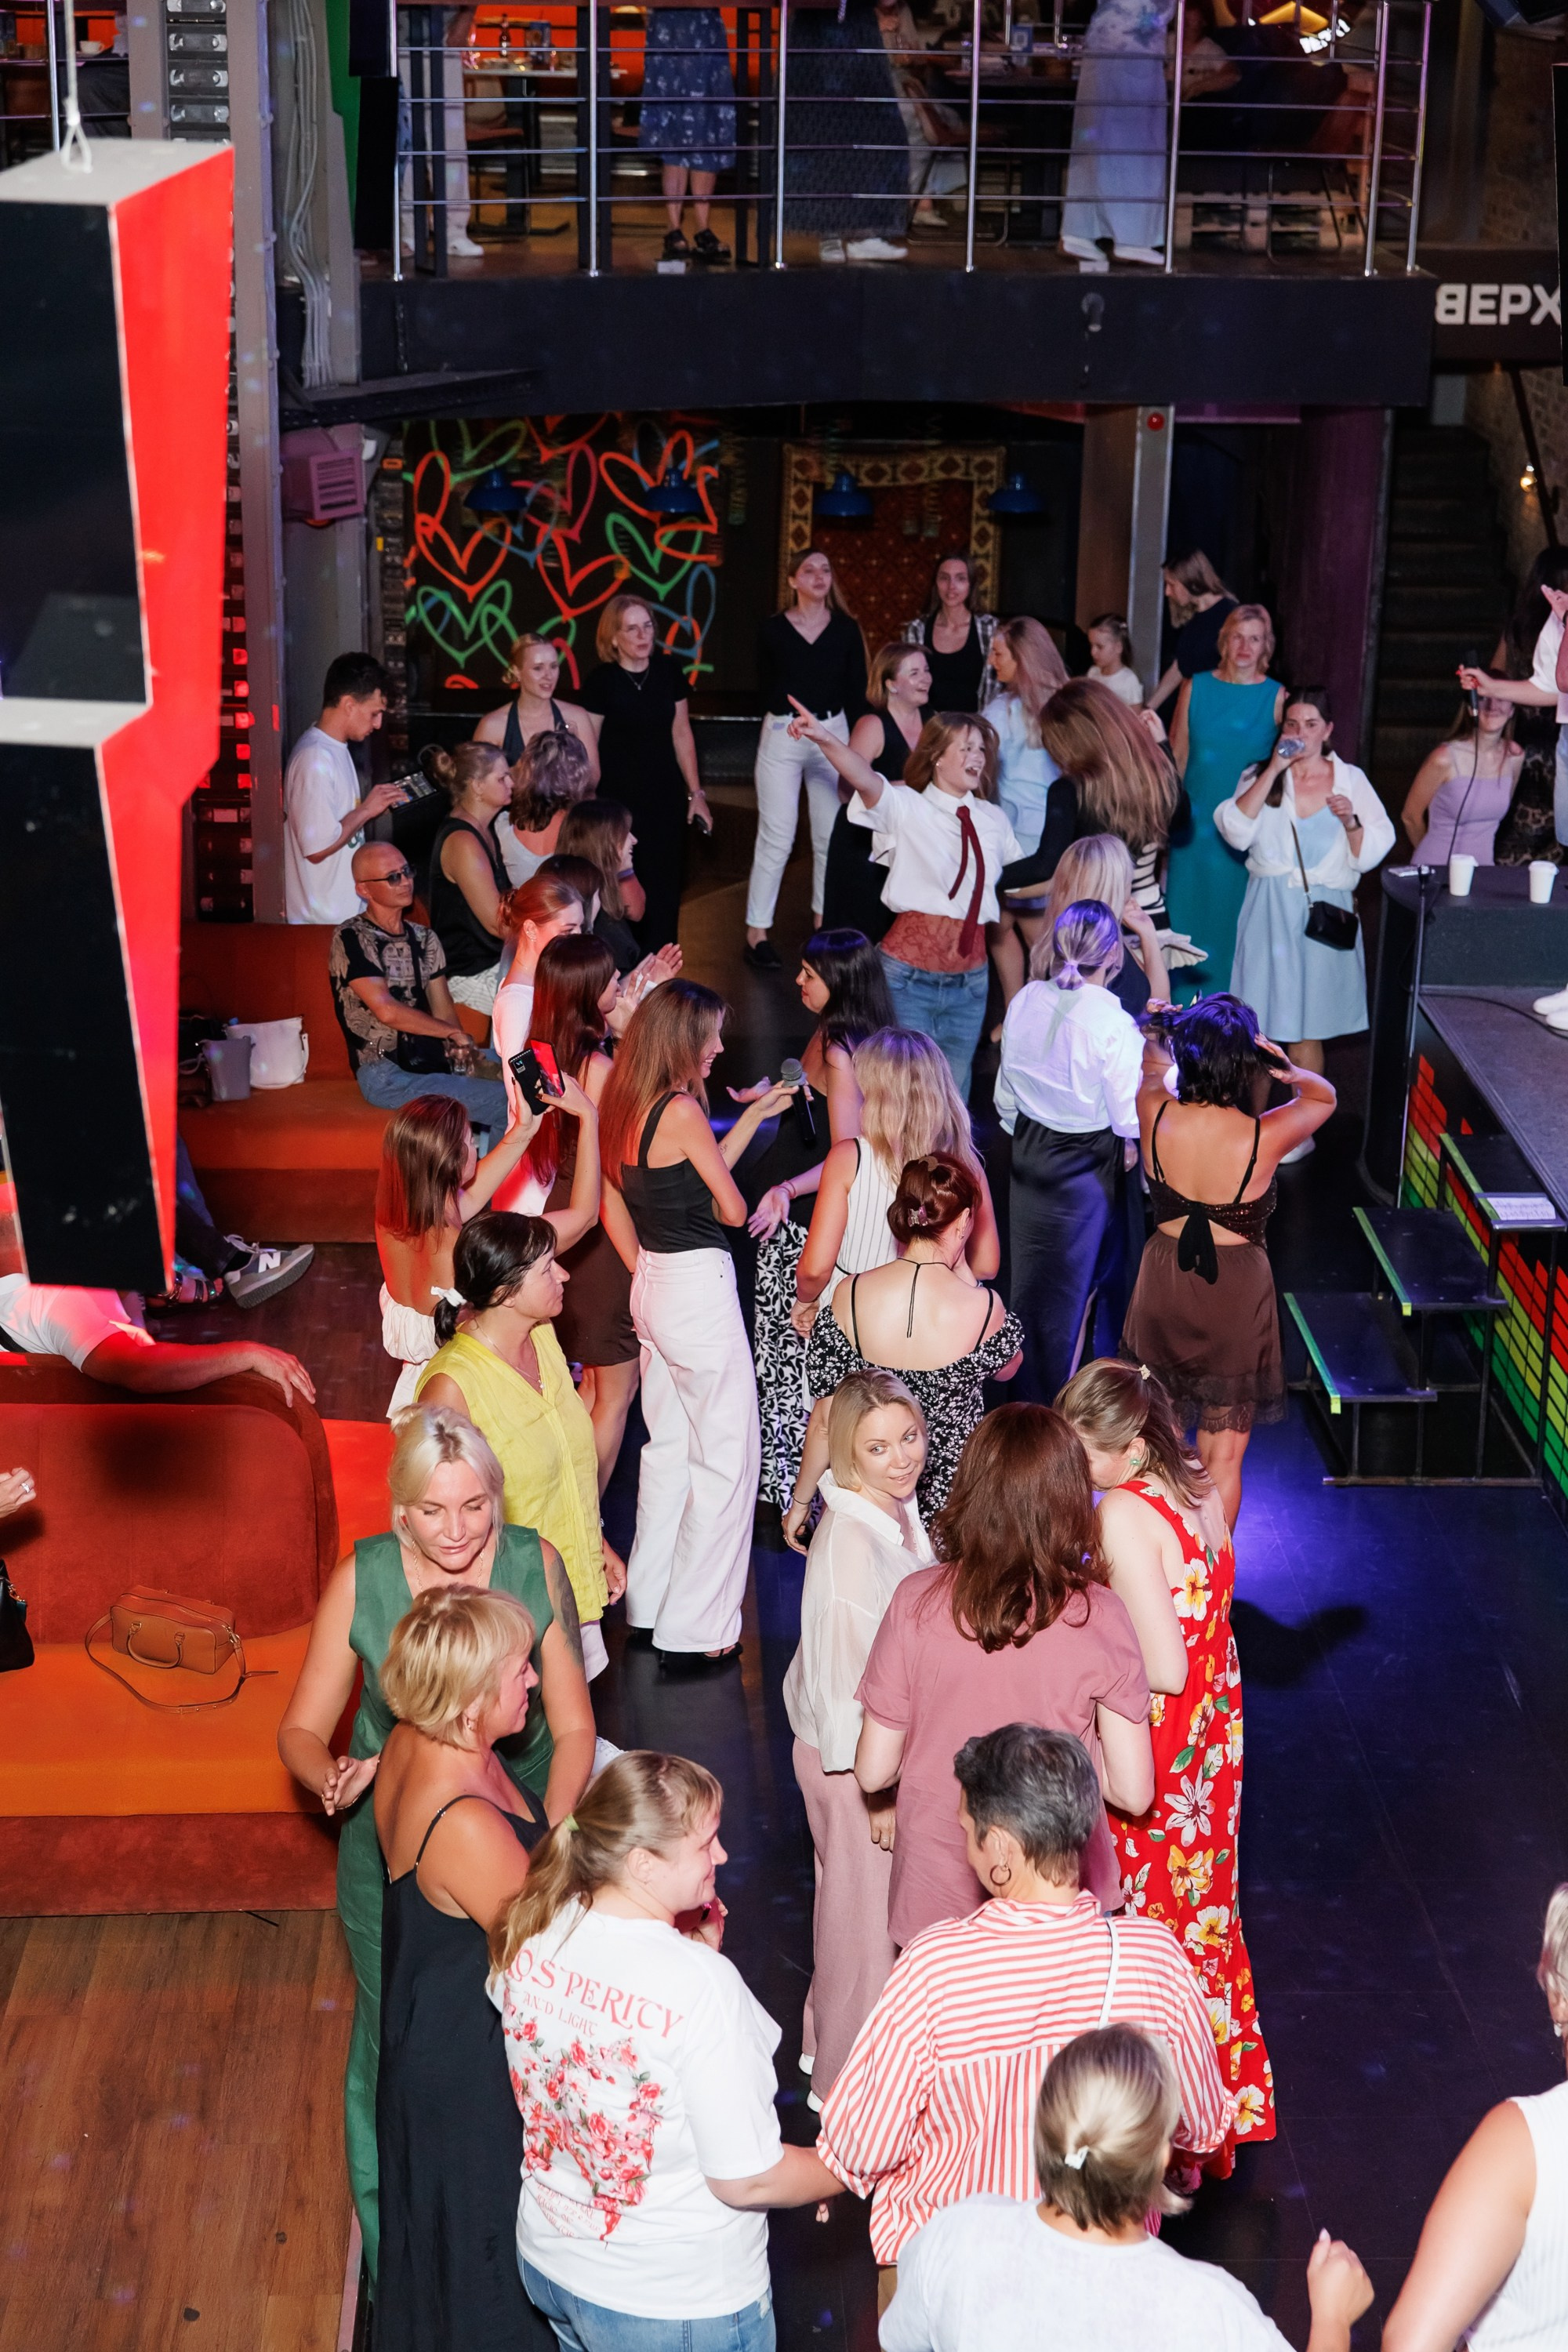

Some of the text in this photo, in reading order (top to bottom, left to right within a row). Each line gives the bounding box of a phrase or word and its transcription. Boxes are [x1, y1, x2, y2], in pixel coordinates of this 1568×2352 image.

[258, 1251, 281, 1273] N
[508, 1948, 684, 2038] OSPERITY
[523, 1991, 598, 2037] AND LIGHT
